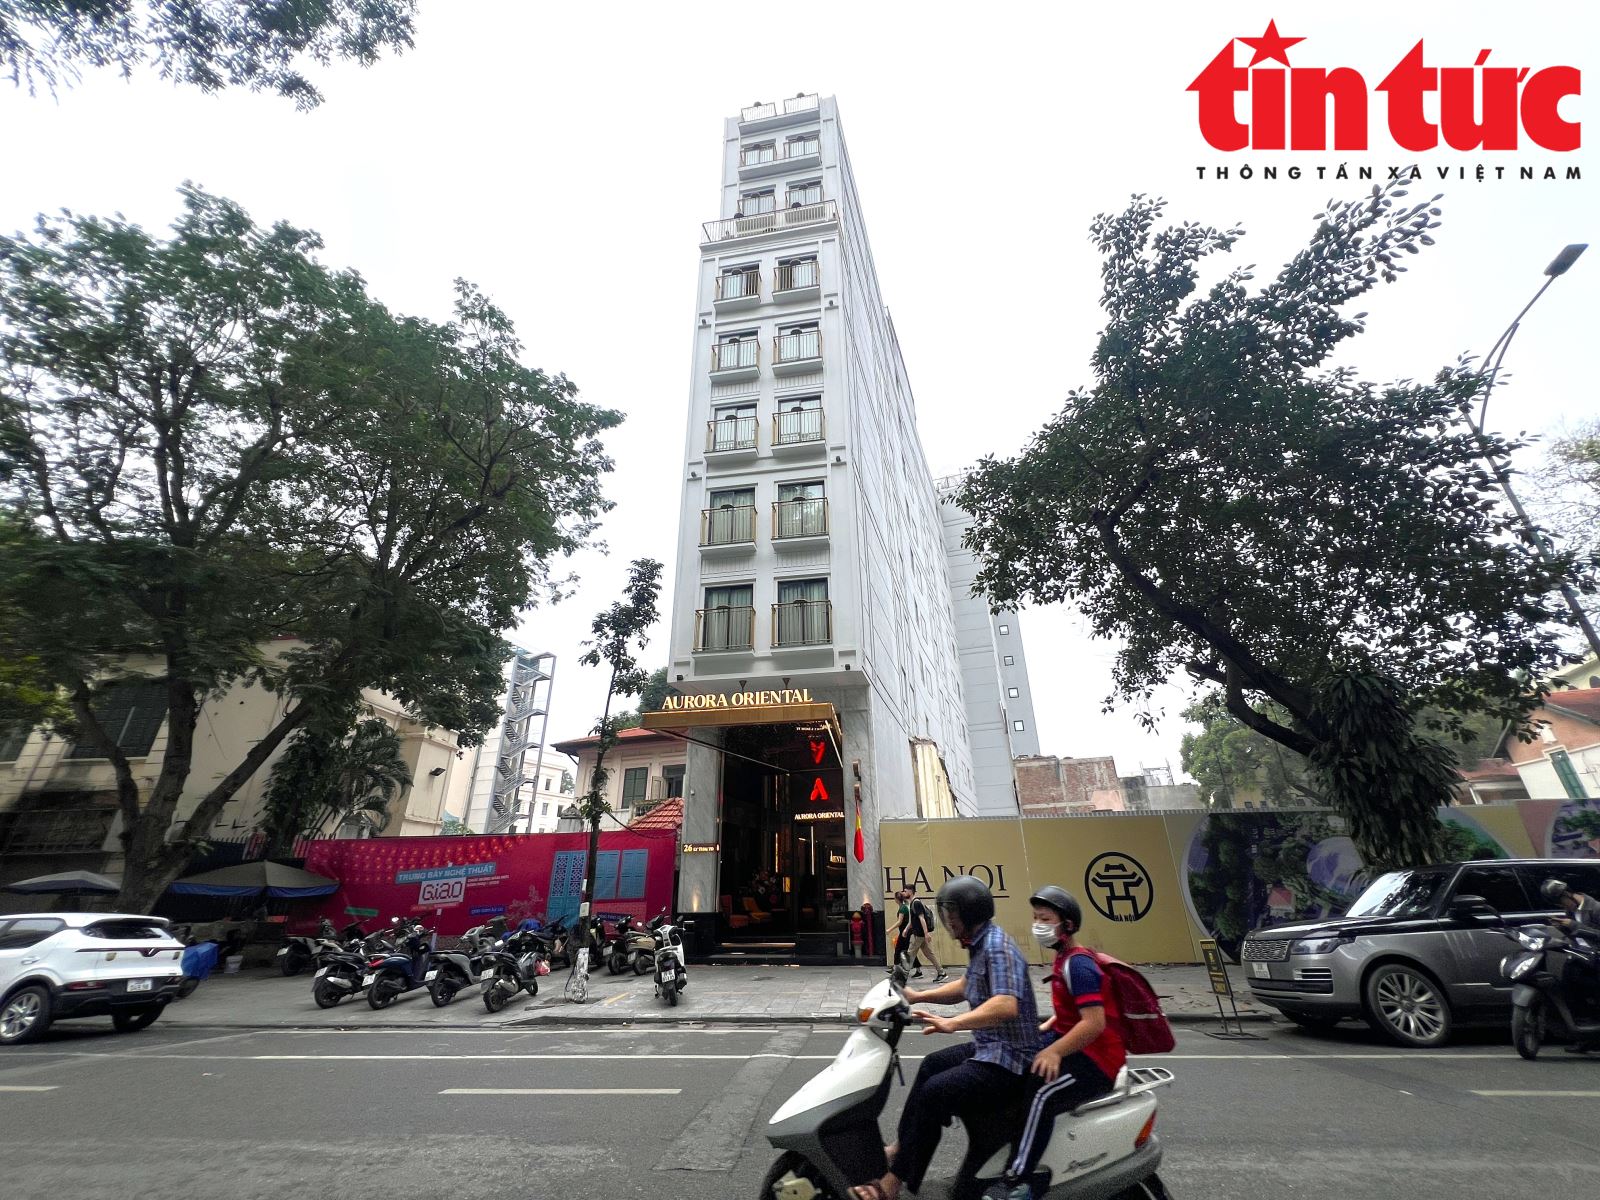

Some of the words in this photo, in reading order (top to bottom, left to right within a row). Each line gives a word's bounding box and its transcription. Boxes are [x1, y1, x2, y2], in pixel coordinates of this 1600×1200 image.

[662, 693, 727, 710] AURORA
[731, 688, 813, 706] ORIENTAL
[794, 812, 817, 820] AURORA
[817, 811, 845, 819] ORIENTAL
[683, 844, 693, 852] 26
